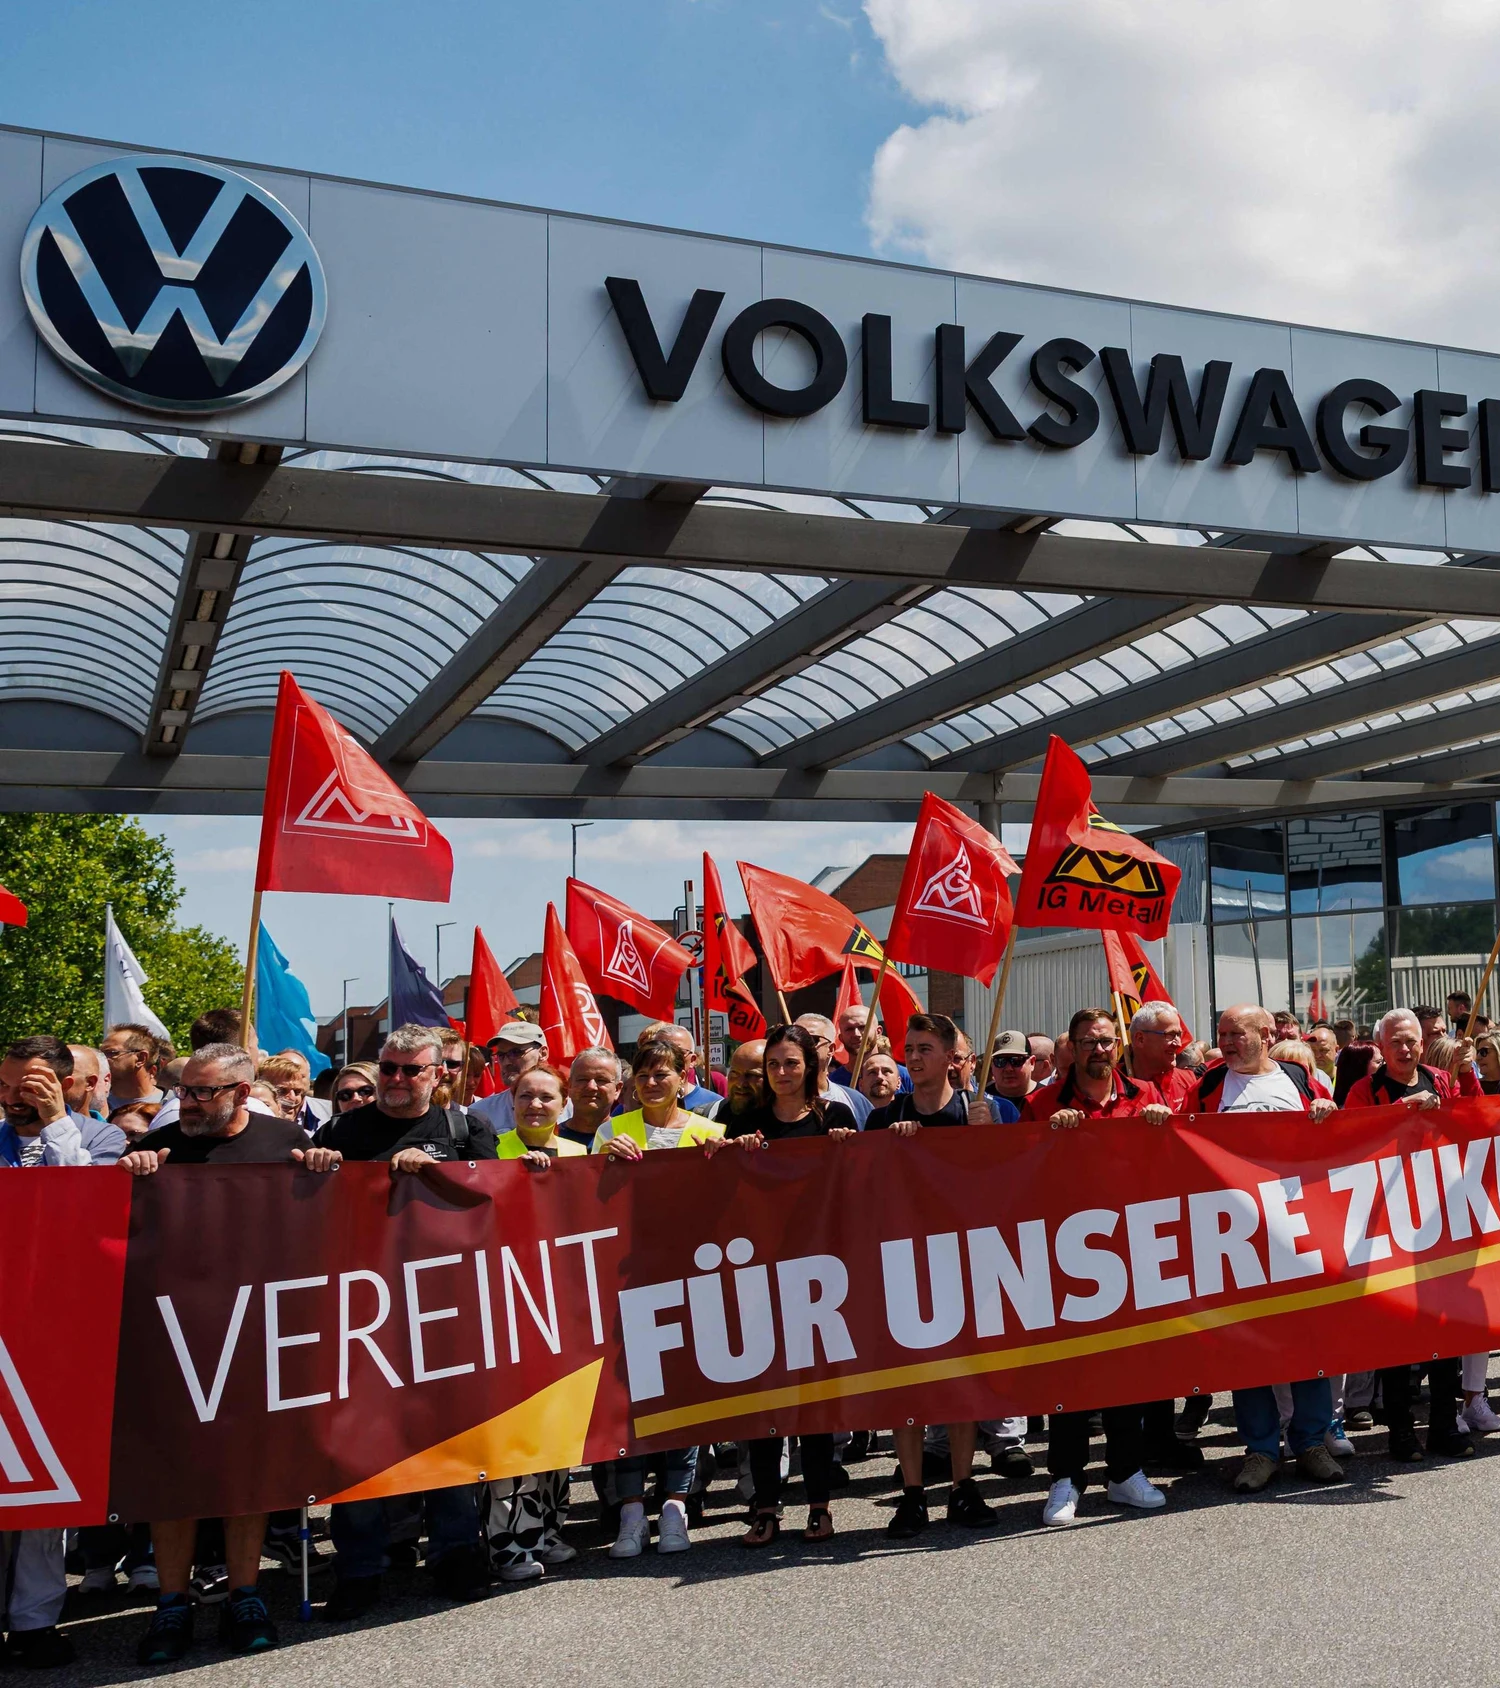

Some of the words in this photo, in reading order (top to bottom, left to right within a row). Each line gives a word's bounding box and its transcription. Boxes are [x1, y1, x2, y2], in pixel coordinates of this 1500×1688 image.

[1037, 885, 1068, 911] IG
[1078, 889, 1165, 924] Metall
[728, 1002, 761, 1033] tall
[155, 1226, 618, 1423] VEREINT
[618, 1237, 857, 1403] FÜR
[880, 1176, 1325, 1350] UNSERE
